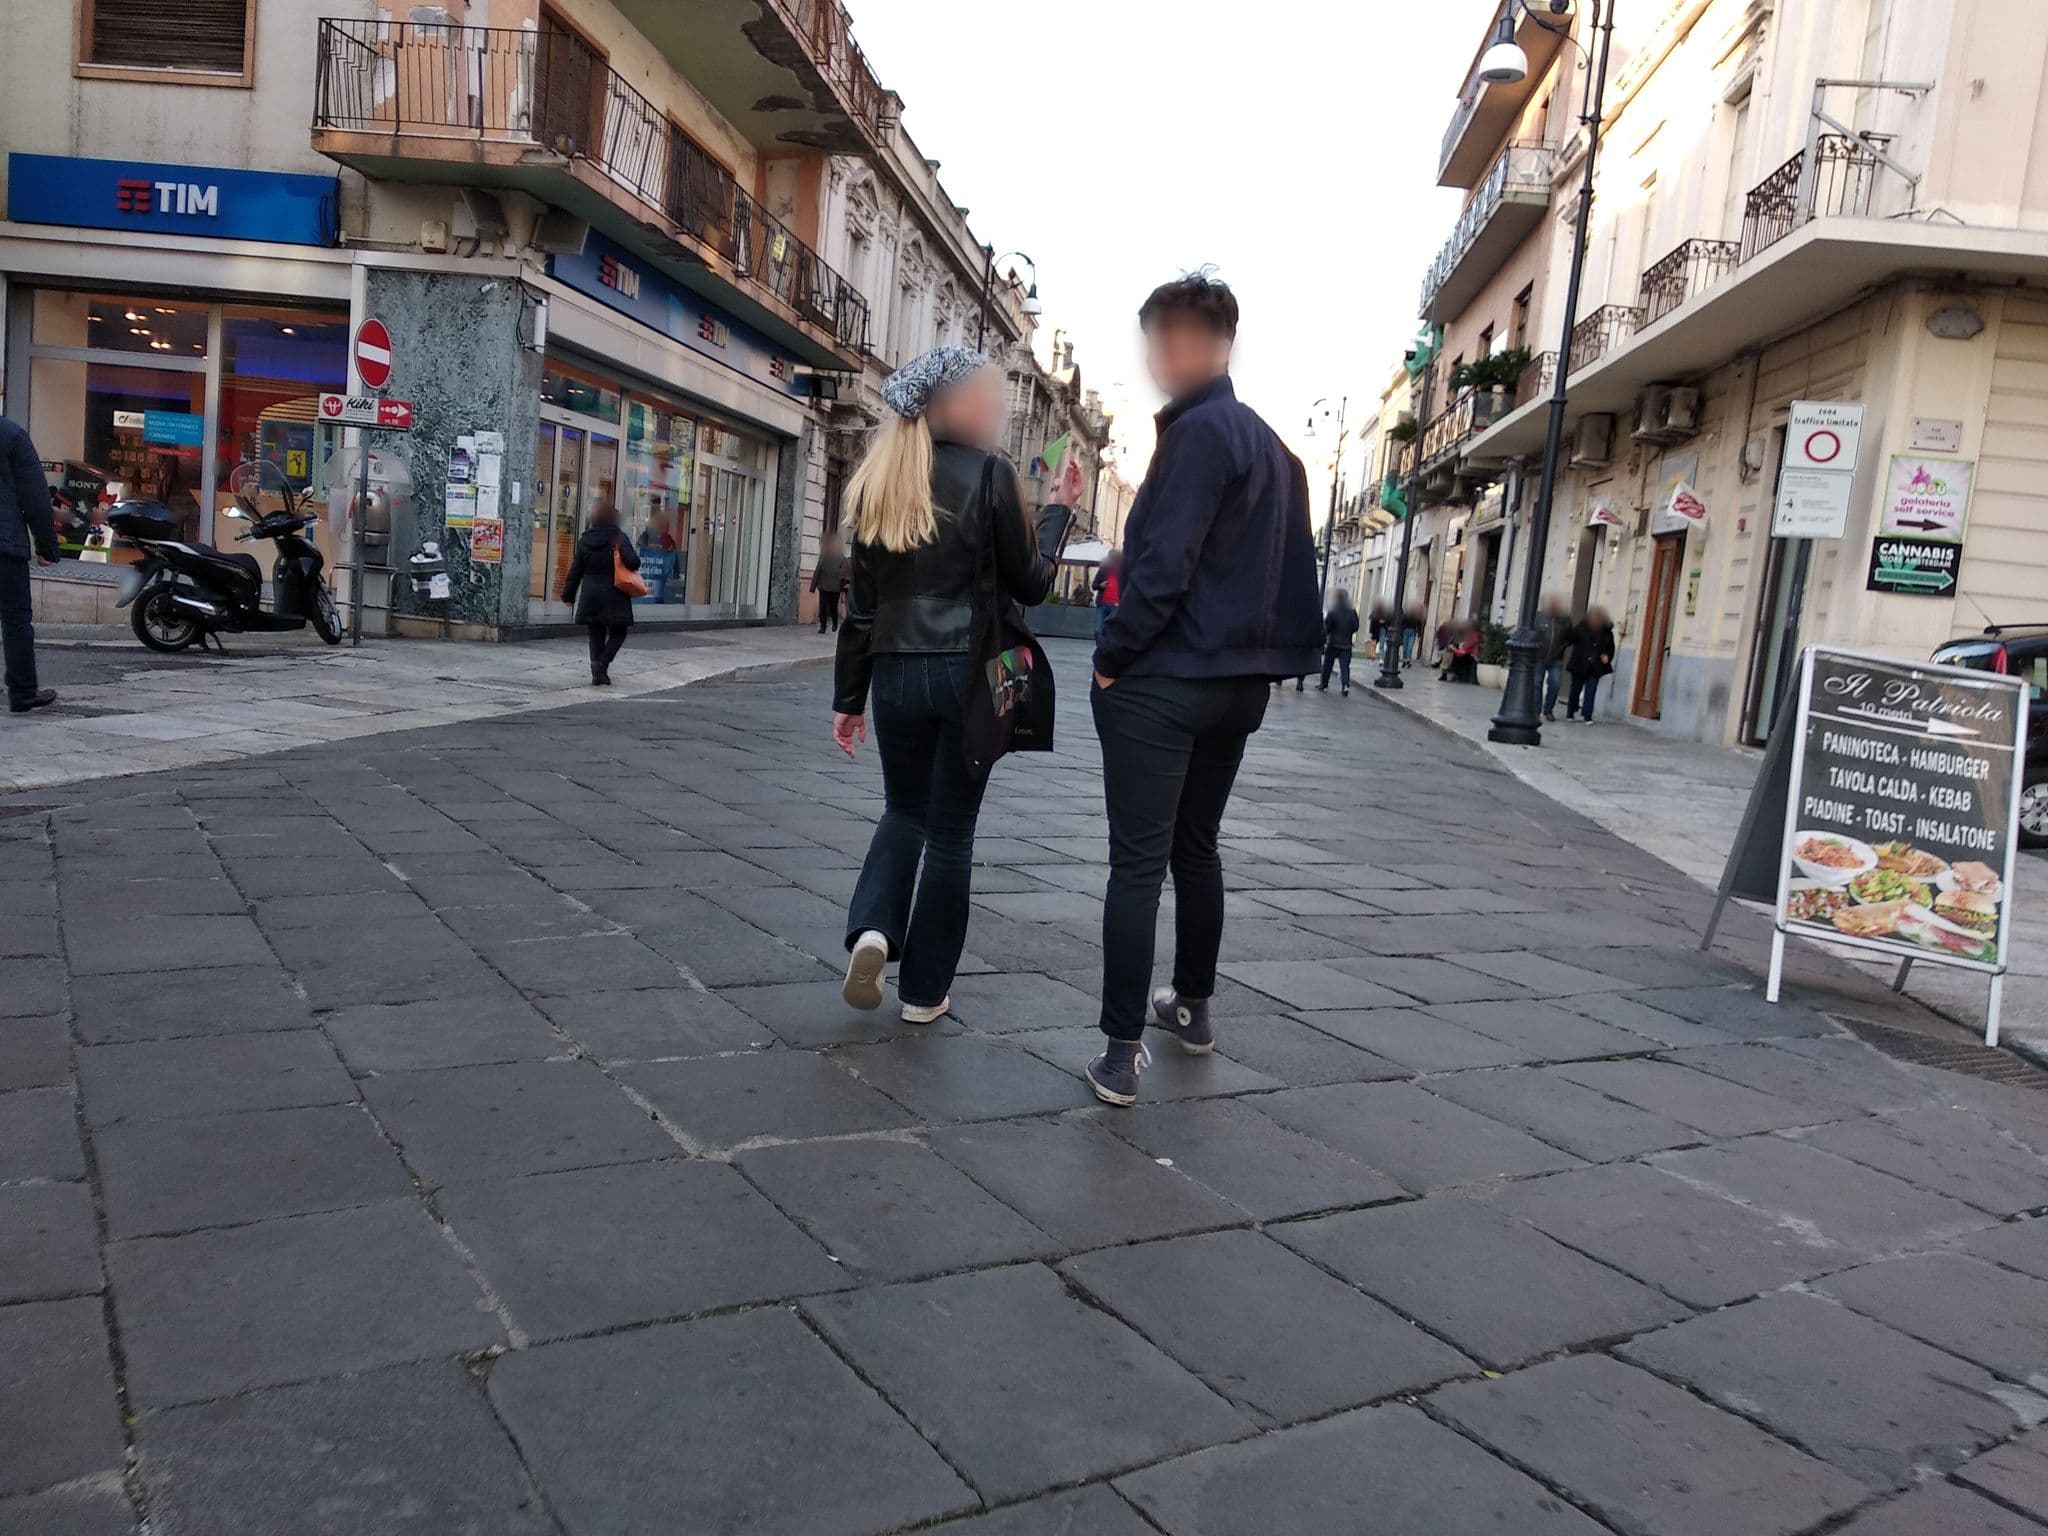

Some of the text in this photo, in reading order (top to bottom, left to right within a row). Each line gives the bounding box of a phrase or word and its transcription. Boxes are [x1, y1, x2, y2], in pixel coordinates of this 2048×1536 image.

[155, 181, 218, 216] TIM
[616, 262, 641, 300] TIM
[346, 398, 375, 410] Kiki
[1794, 417, 1858, 427] traffico limitato
[67, 480, 99, 490] SONY
[1900, 497, 1951, 508] gelateria
[1916, 508, 1955, 517] service
[1879, 543, 1954, 560] CANNABIS
[1904, 557, 1952, 568] AMSTERDAM
[1823, 673, 2004, 722] Il Patriota
[1823, 731, 1900, 765] PANINOTECA
[1910, 748, 1991, 780] HAMBURGER
[1829, 767, 1875, 795] TAVOLA
[1877, 776, 1918, 803] CALDA
[1929, 785, 1972, 812] KEBAB
[1804, 796, 1856, 825] PIADINE
[1865, 808, 1906, 834] TOAST
[1915, 817, 1996, 851] INSALATONE
